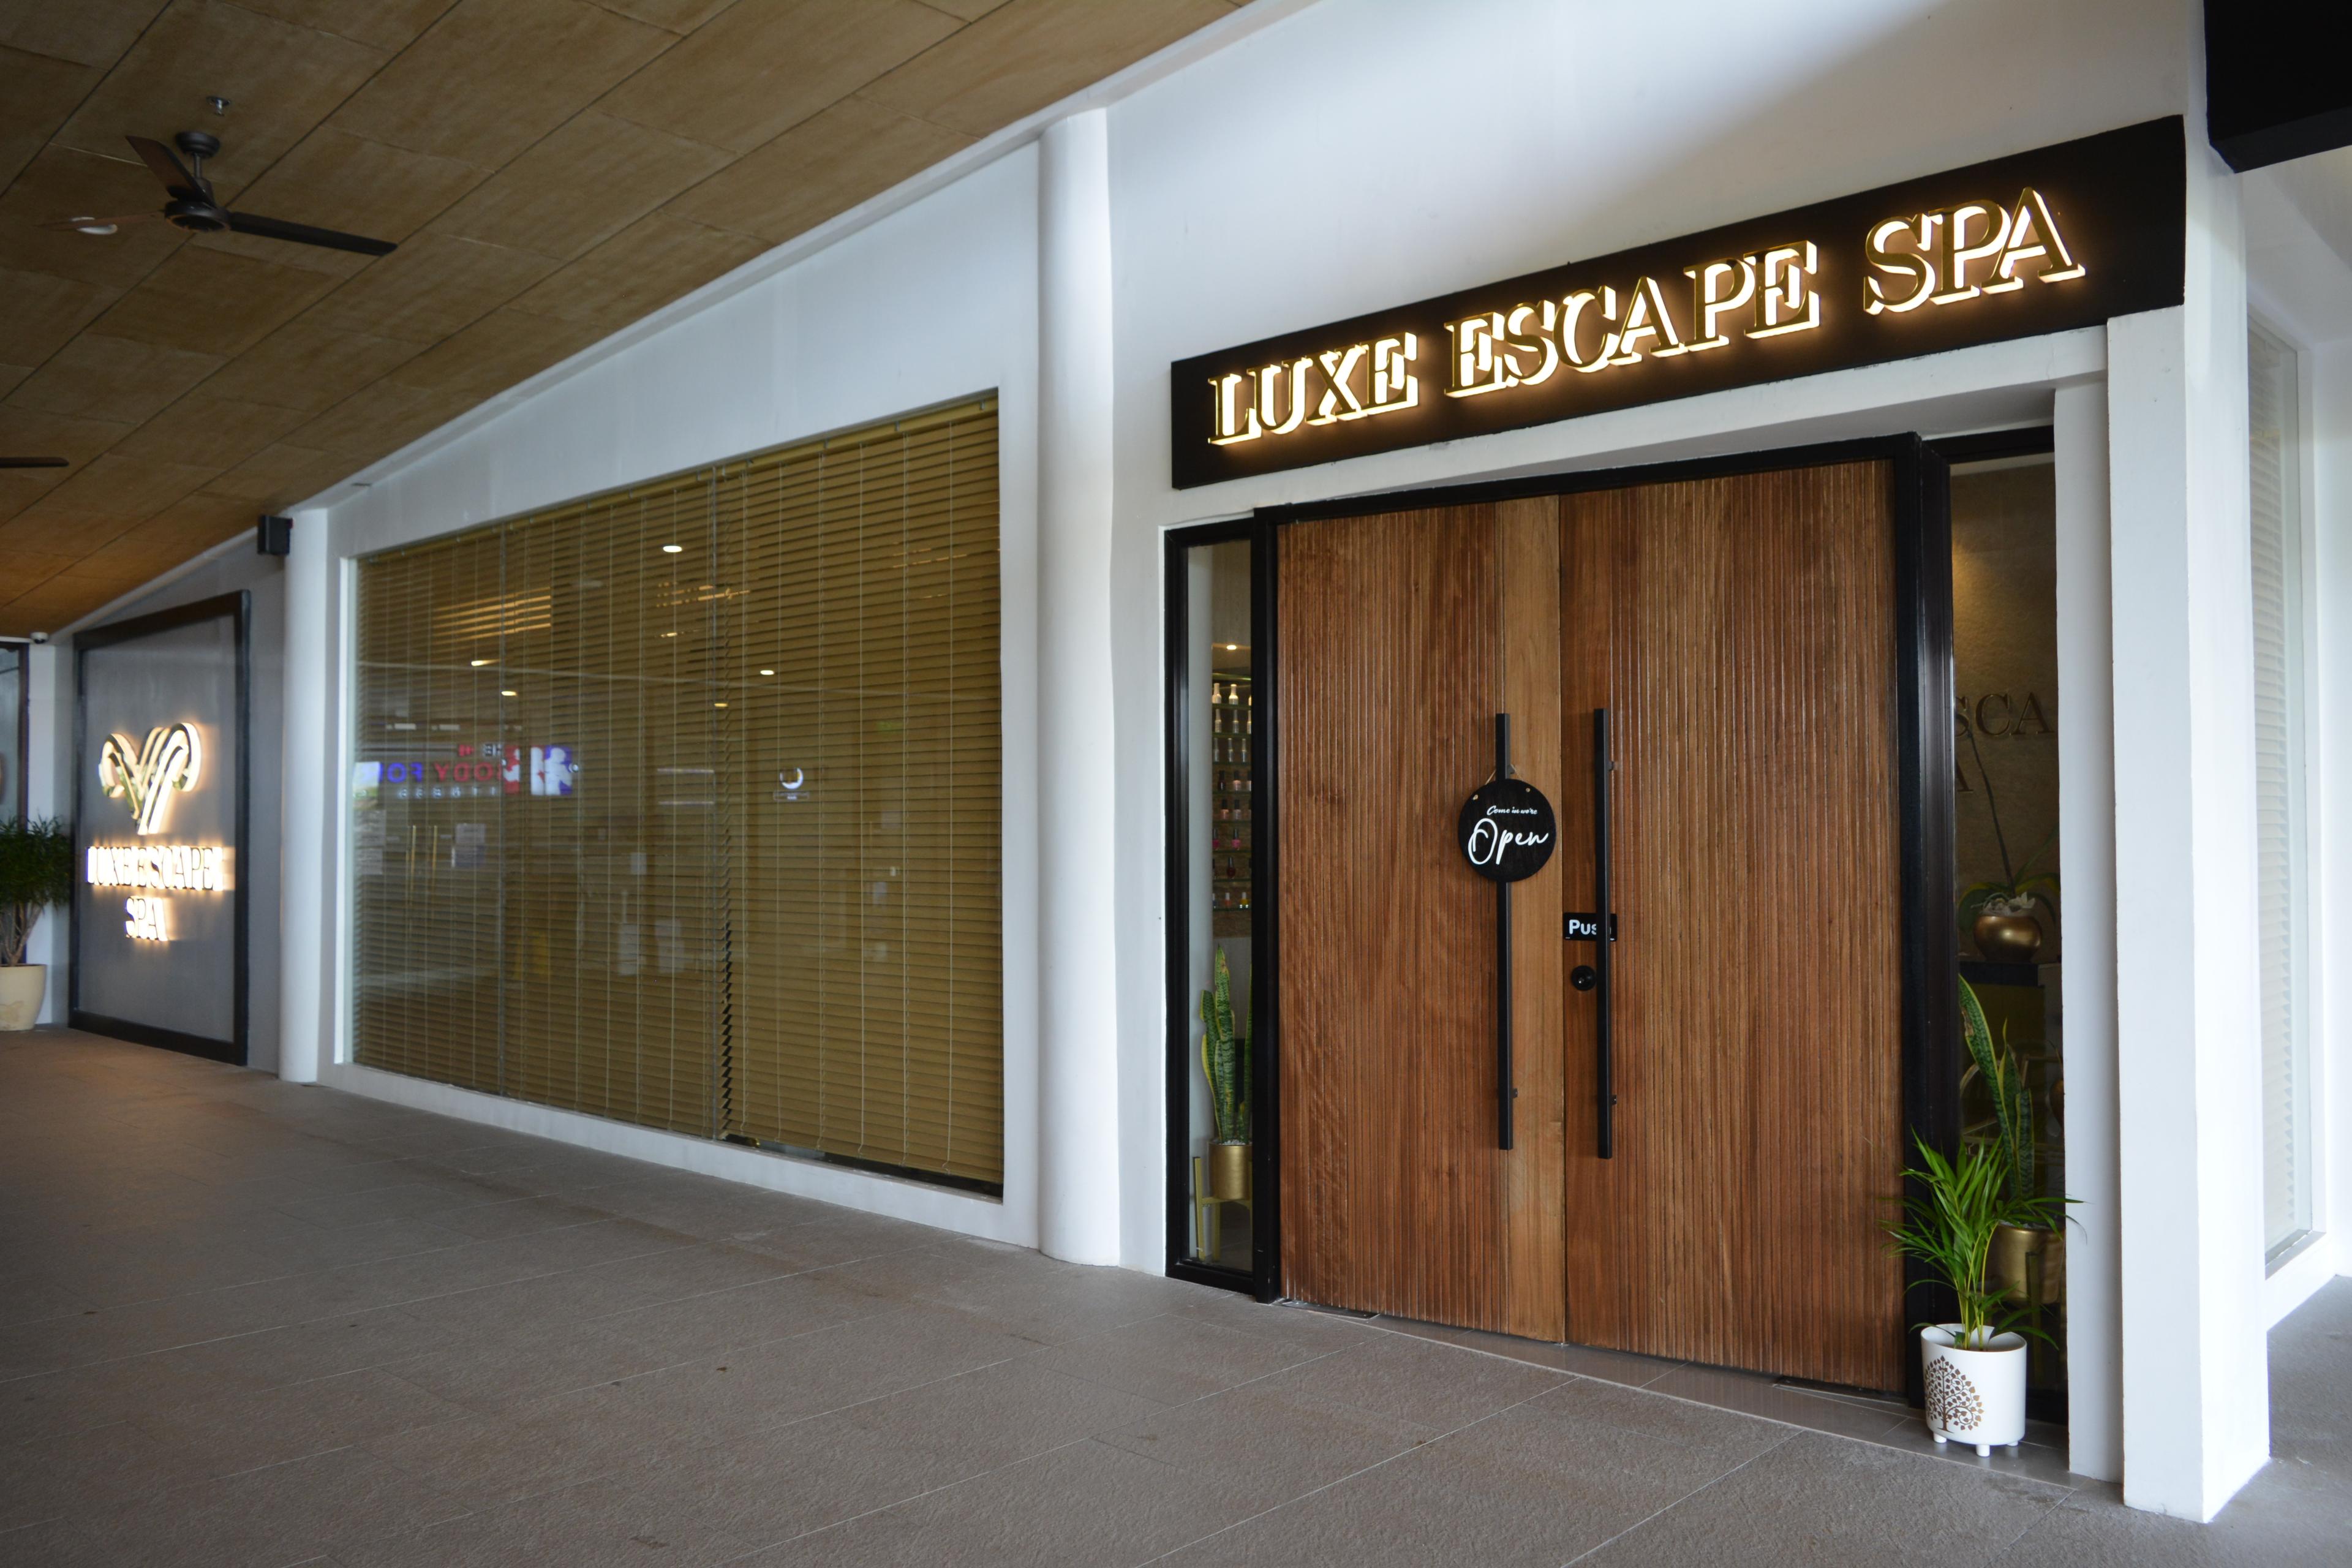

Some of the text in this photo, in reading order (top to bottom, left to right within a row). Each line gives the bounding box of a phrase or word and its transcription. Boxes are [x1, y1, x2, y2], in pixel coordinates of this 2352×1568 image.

[1207, 186, 2086, 446] LUXE ESCAPE SPA
[1954, 692, 2054, 737] SCA
[1487, 805, 1510, 815] Come
[1468, 818, 1549, 865] Open
[124, 896, 168, 941] SPA
[1569, 919, 1611, 935] Pus
